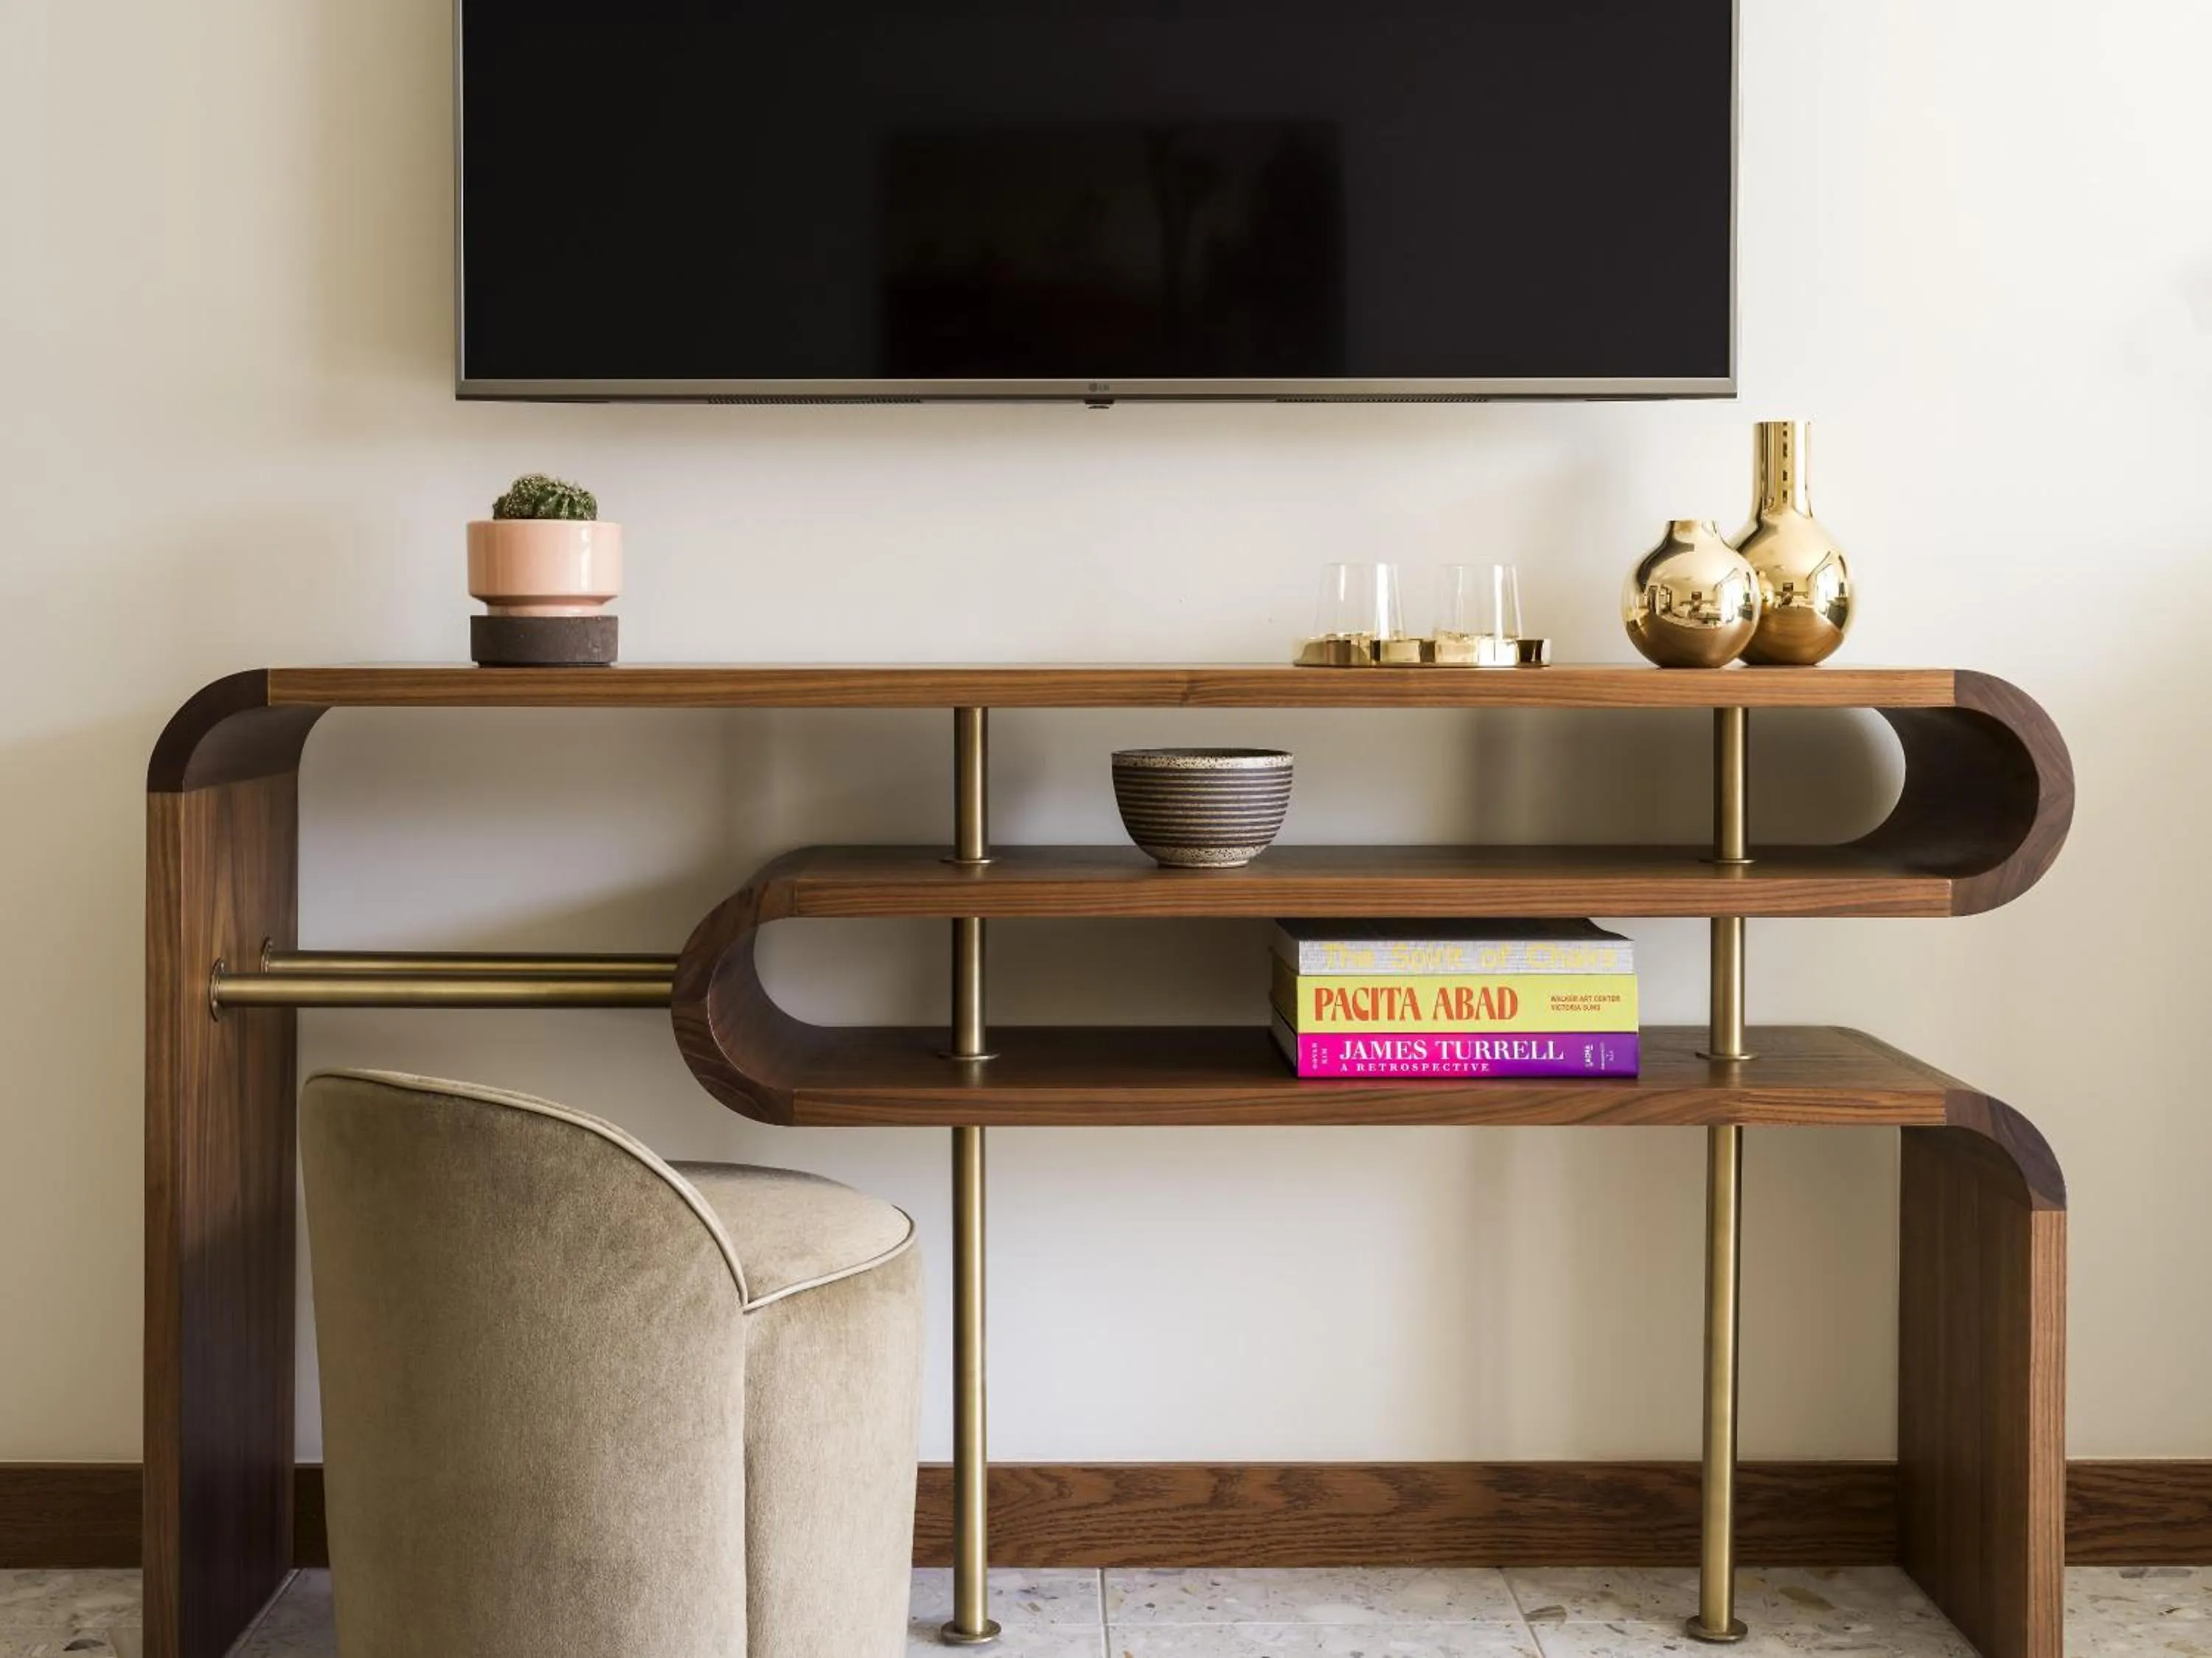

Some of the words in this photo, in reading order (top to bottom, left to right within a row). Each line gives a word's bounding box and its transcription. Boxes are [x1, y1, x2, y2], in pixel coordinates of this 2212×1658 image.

[1322, 941, 1373, 969] The
[1481, 941, 1510, 969] of
[1315, 987, 1422, 1021] PACITA
[1433, 987, 1518, 1021] ABAD
[1339, 1039, 1427, 1060] JAMES
[1435, 1040, 1565, 1060] TURRELL
[1340, 1064, 1348, 1072] A
[1357, 1063, 1490, 1072] RETROSPECTIVE
